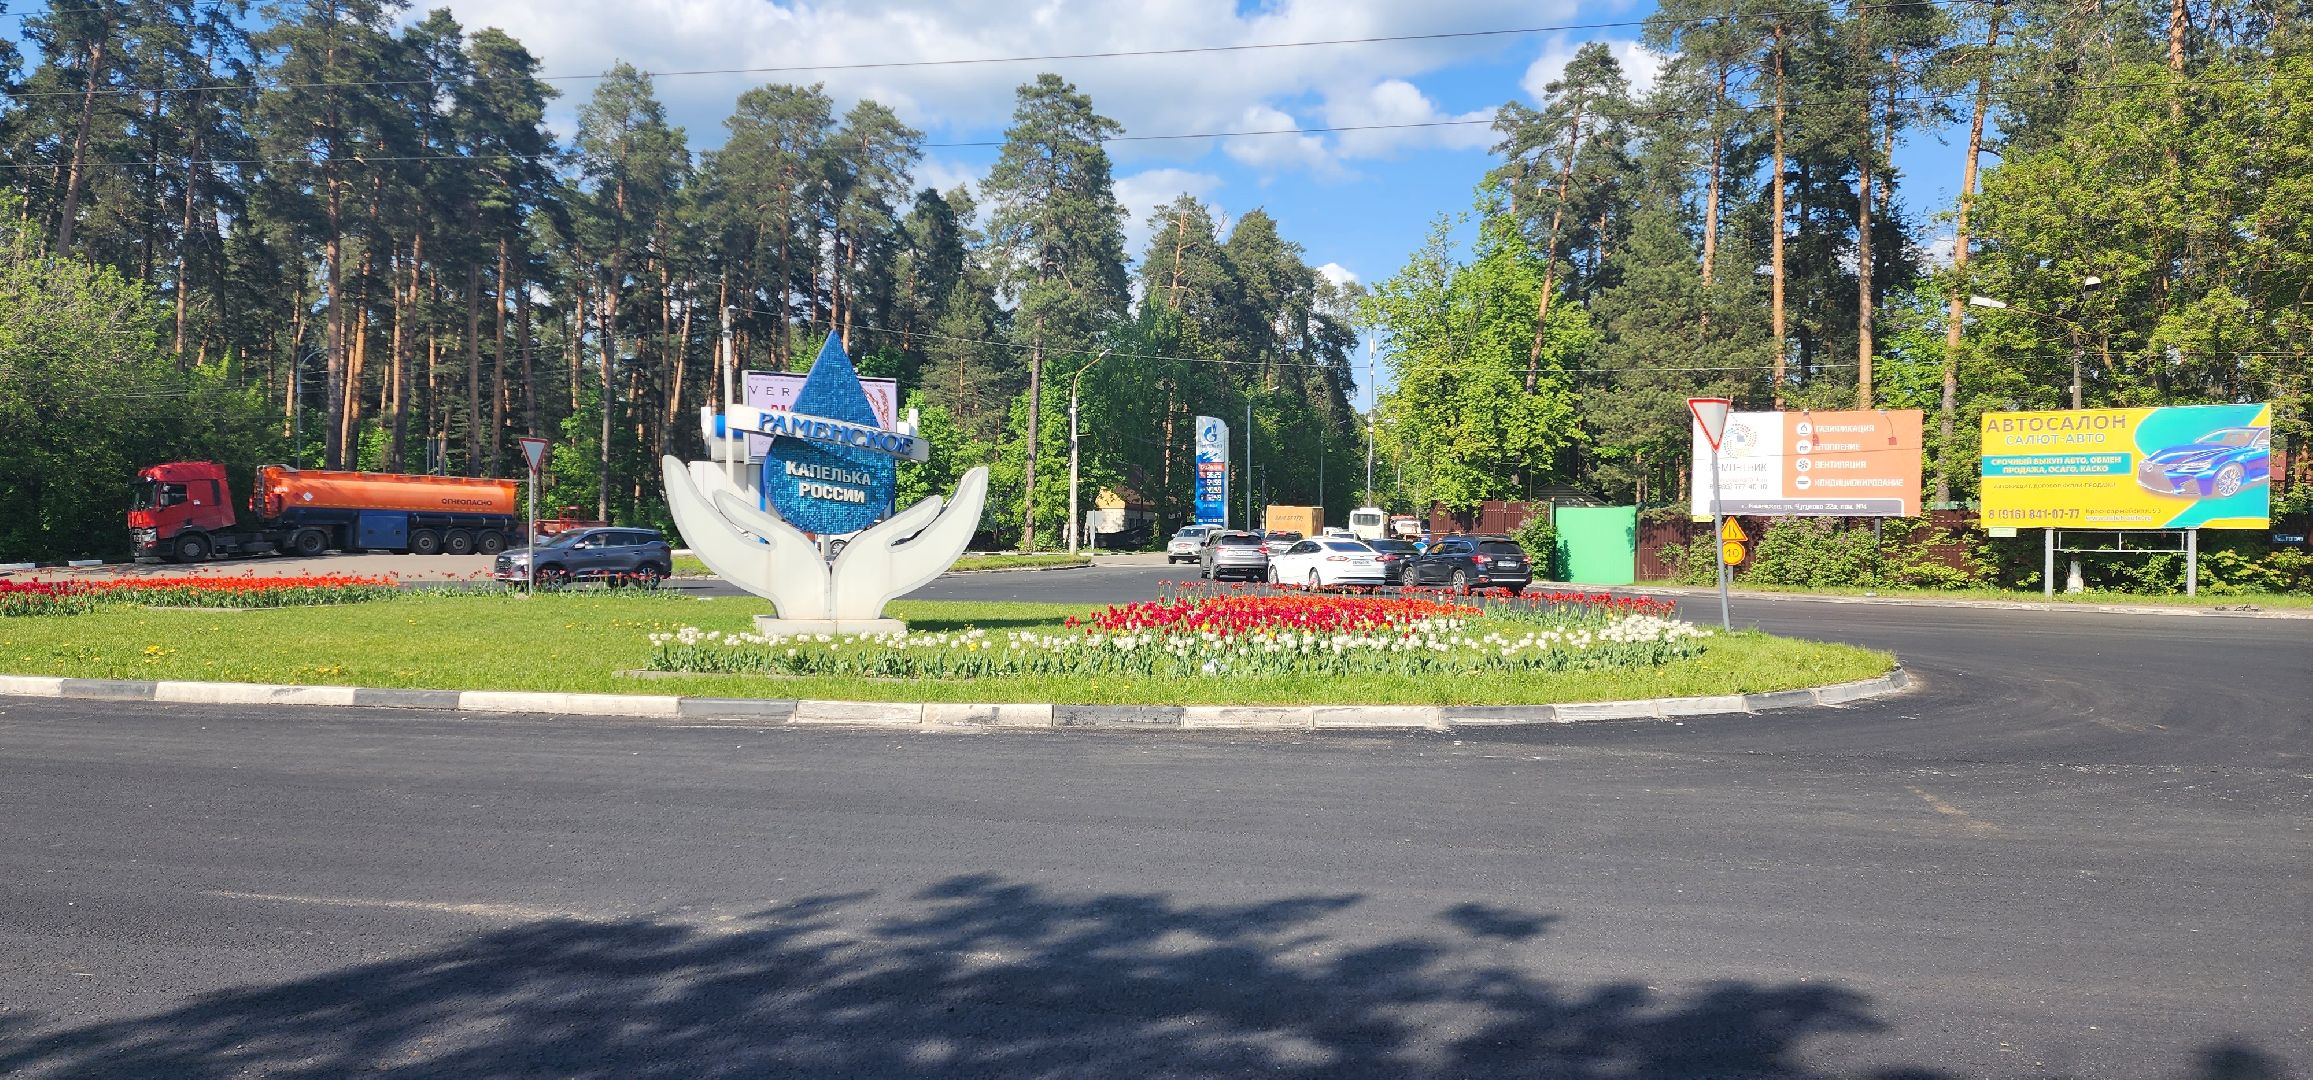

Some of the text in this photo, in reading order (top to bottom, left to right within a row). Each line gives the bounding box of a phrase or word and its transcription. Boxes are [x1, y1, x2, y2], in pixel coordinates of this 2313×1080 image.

[1986, 415, 2126, 433] АВТОСАЛОН
[759, 412, 914, 456] РАМЕНСКОЕ
[2005, 433, 2105, 445] САЛЮТ-АВТО
[1991, 457, 2032, 465] СРОЧНЫЙ
[2034, 457, 2063, 465] ВЫКУП
[2064, 457, 2089, 465] АВТО,
[786, 461, 871, 485] КАПЕЛЬКА
[2003, 466, 2047, 474] ПРОДАЖА,
[799, 483, 865, 503] РОССИИ
[441, 498, 493, 506] ОГНЕОПАСНО
[1989, 508, 2080, 519] 8 (916) 841-07-77
[1726, 549, 1740, 557] 10
